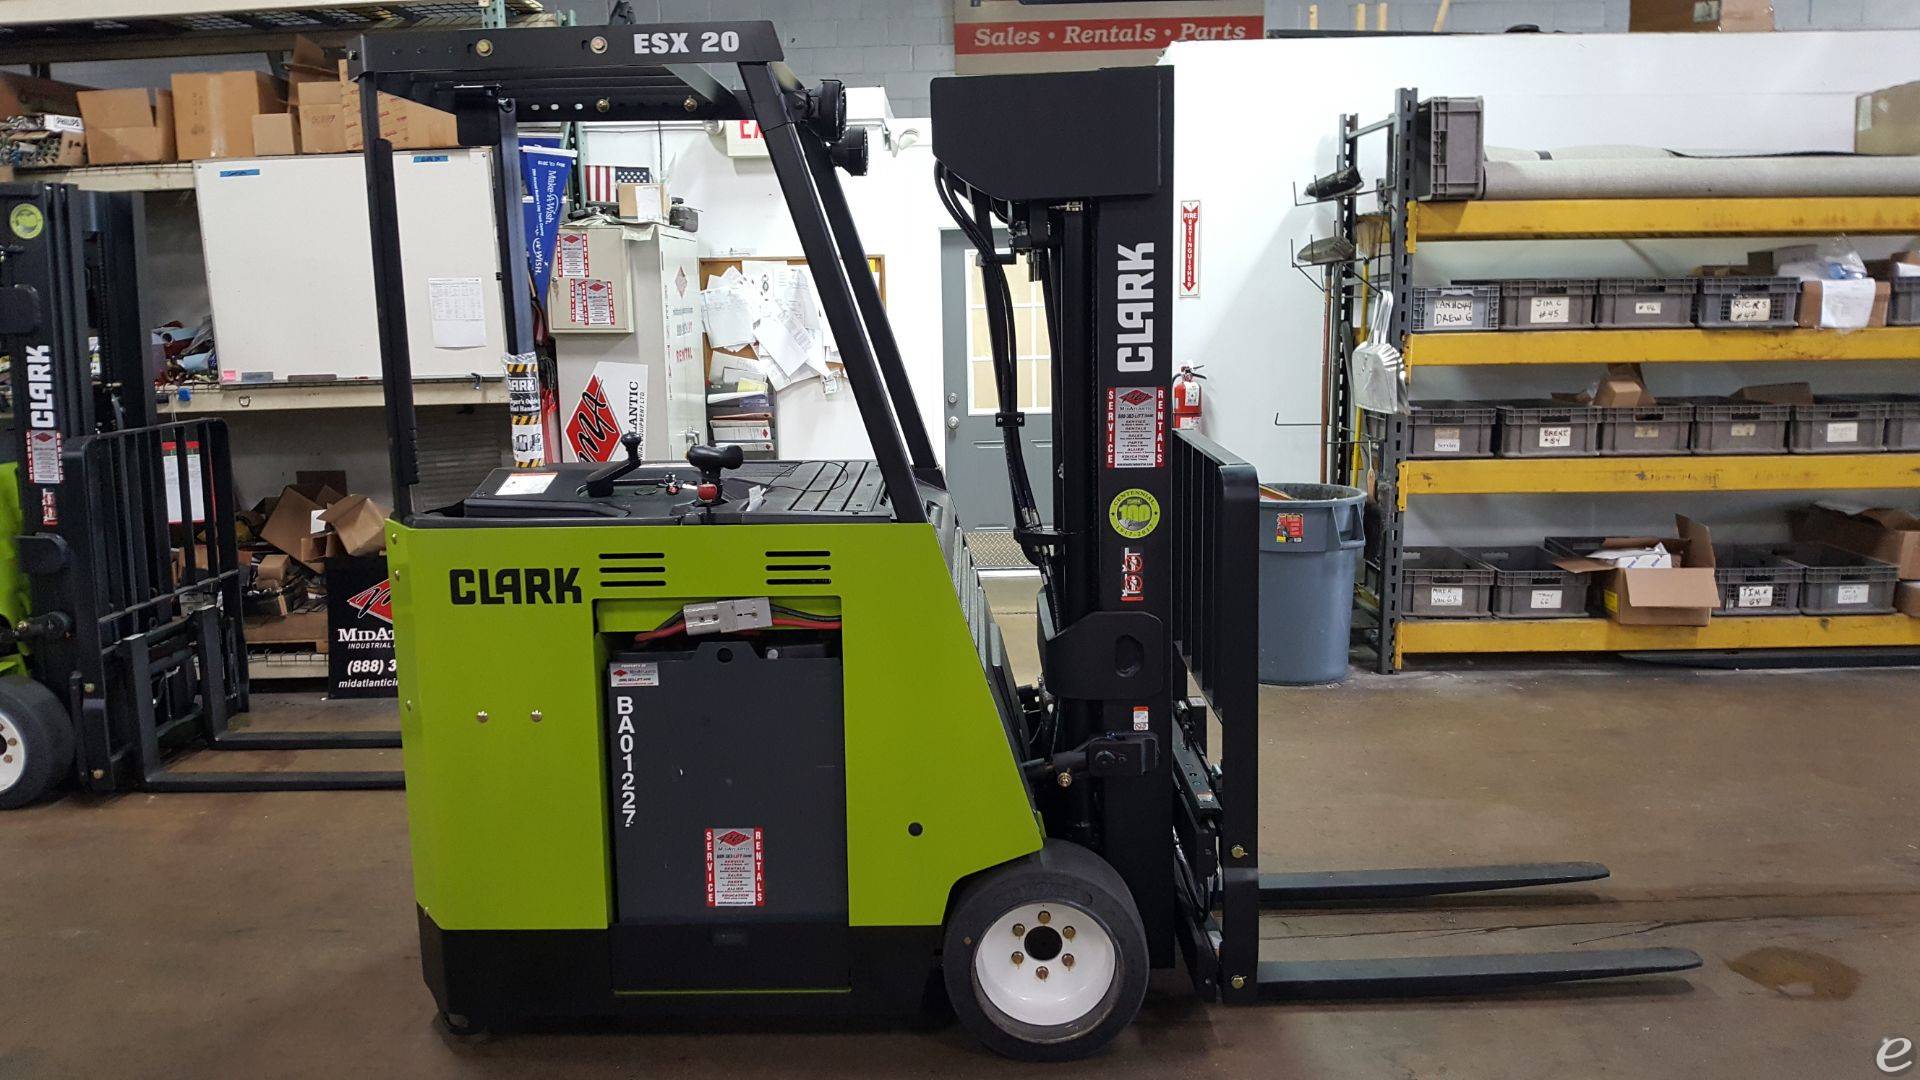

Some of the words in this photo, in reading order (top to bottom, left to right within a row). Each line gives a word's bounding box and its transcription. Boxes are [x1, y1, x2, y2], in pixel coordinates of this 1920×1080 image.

[633, 32, 690, 55] ESX
[701, 31, 740, 53] 20
[975, 28, 1041, 47] Sales
[1063, 23, 1156, 44] Rentals
[1179, 23, 1246, 41] Parts
[1117, 242, 1154, 372] CLARK
[1436, 313, 1461, 324] DREW
[1466, 312, 1472, 321] G
[1536, 299, 1552, 307] JIM
[26, 345, 55, 428] CLARK
[1107, 390, 1115, 463] SERVICE
[449, 567, 582, 604] CLARK
[347, 659, 384, 676] (888)
[616, 696, 636, 827] BA01227
[706, 831, 714, 902] SERVICE
[755, 831, 763, 902] RENTALS
